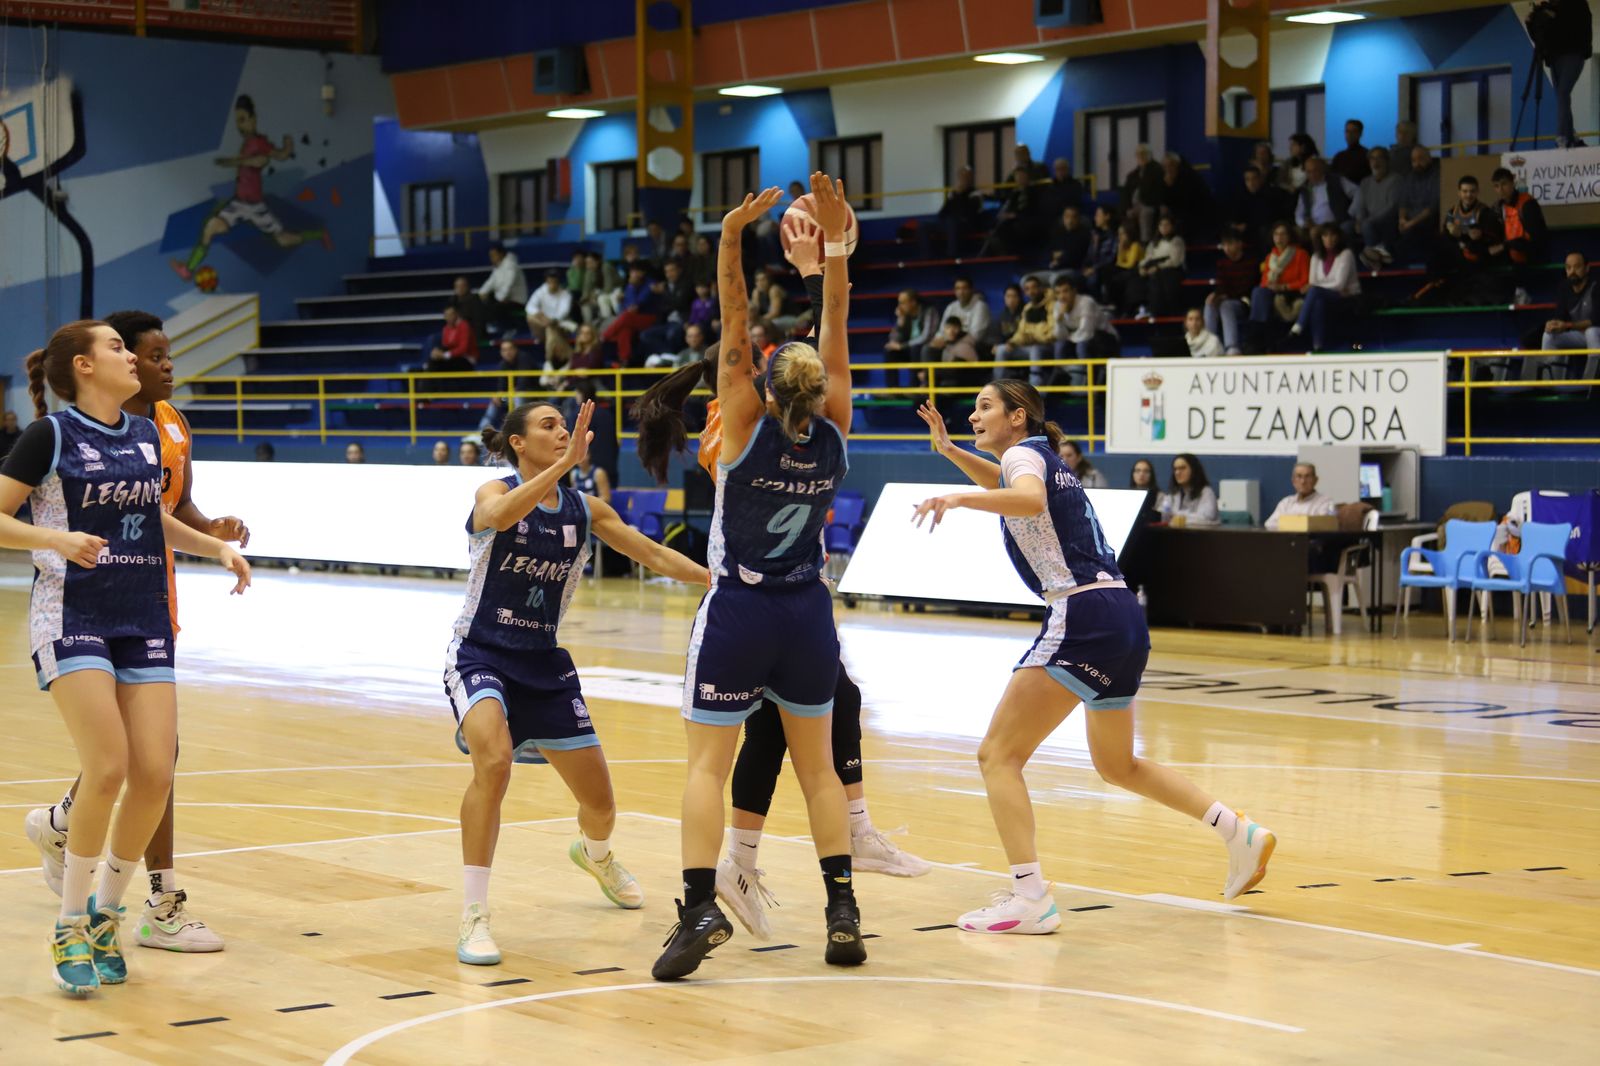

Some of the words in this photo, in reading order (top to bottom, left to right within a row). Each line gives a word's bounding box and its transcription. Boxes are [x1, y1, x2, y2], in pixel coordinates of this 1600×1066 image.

[1533, 163, 1600, 179] AYUNTAMIE
[1532, 183, 1552, 200] DE
[1188, 369, 1409, 395] AYUNTAMIENTO
[1188, 407, 1226, 440] DE
[1246, 405, 1407, 441] ZAMORA
[120, 513, 146, 541] 18
[765, 504, 811, 558] 9
[96, 549, 162, 565] nnova-tsn
[525, 585, 545, 609] 10
[149, 873, 163, 895] PEAK
